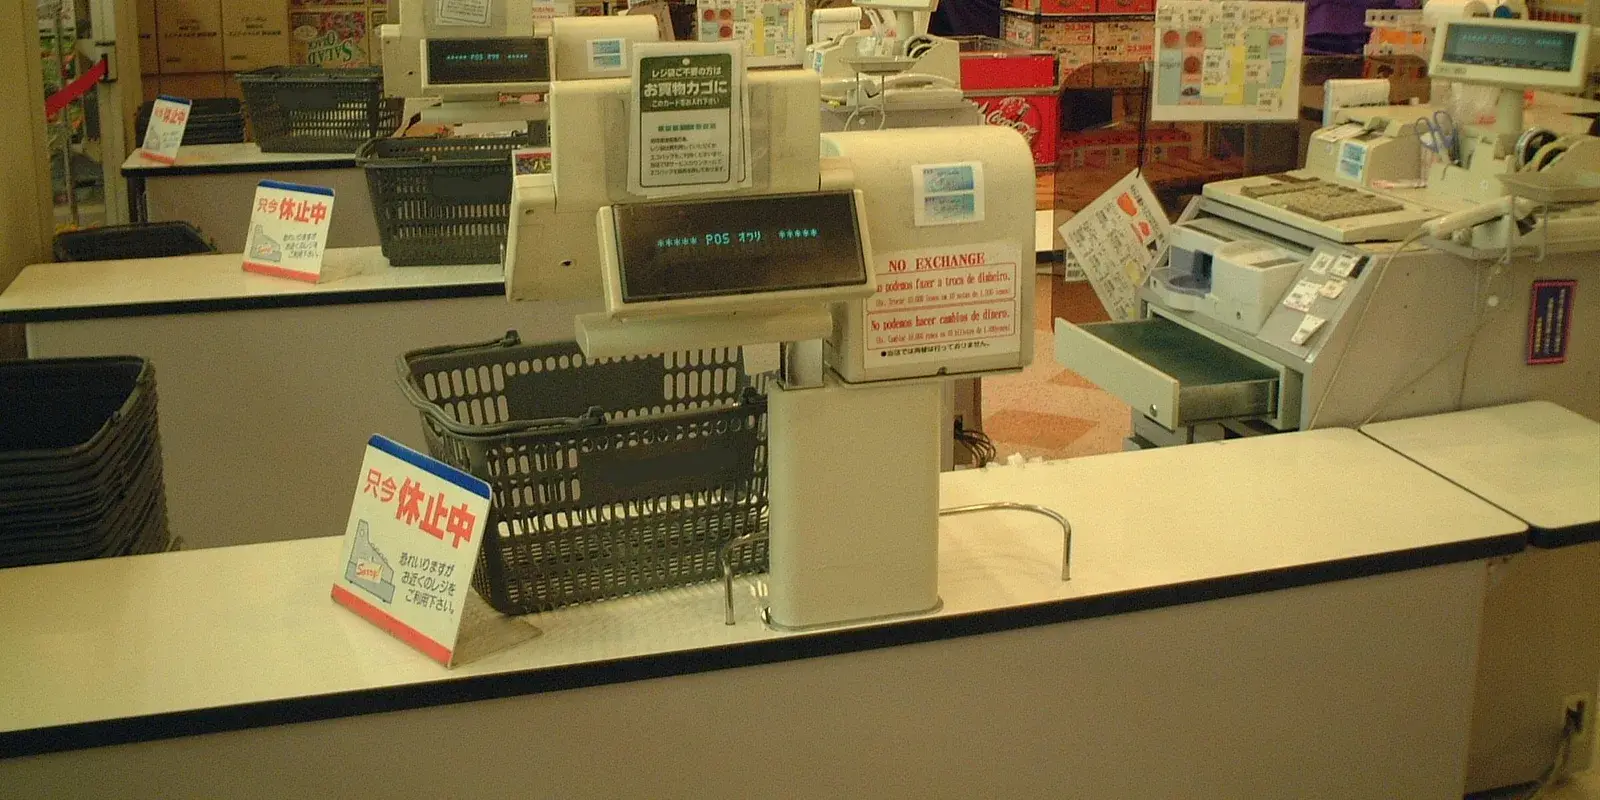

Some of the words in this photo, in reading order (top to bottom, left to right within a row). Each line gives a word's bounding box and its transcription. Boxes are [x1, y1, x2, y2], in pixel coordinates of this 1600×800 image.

[644, 80, 728, 97] お買物カゴに
[257, 197, 327, 225] 只今休止中
[705, 232, 730, 246] POS
[888, 259, 907, 272] NO
[916, 252, 985, 270] EXCHANGE
[885, 279, 913, 293] podemos
[915, 277, 935, 290] fazer
[945, 275, 964, 286] troca
[967, 273, 975, 284] de
[978, 271, 1011, 283] dinheiro.
[871, 320, 880, 331] No
[883, 318, 913, 331] podemos
[915, 315, 936, 327] hacer
[939, 311, 968, 324] cambios
[971, 310, 980, 321] de
[982, 308, 1010, 319] dinero.
[364, 468, 476, 549] 只今休止中
[399, 551, 455, 577] 恐れいりますが
[401, 571, 457, 597] お近くのレジを
[405, 588, 455, 615] ご利用下さい。
